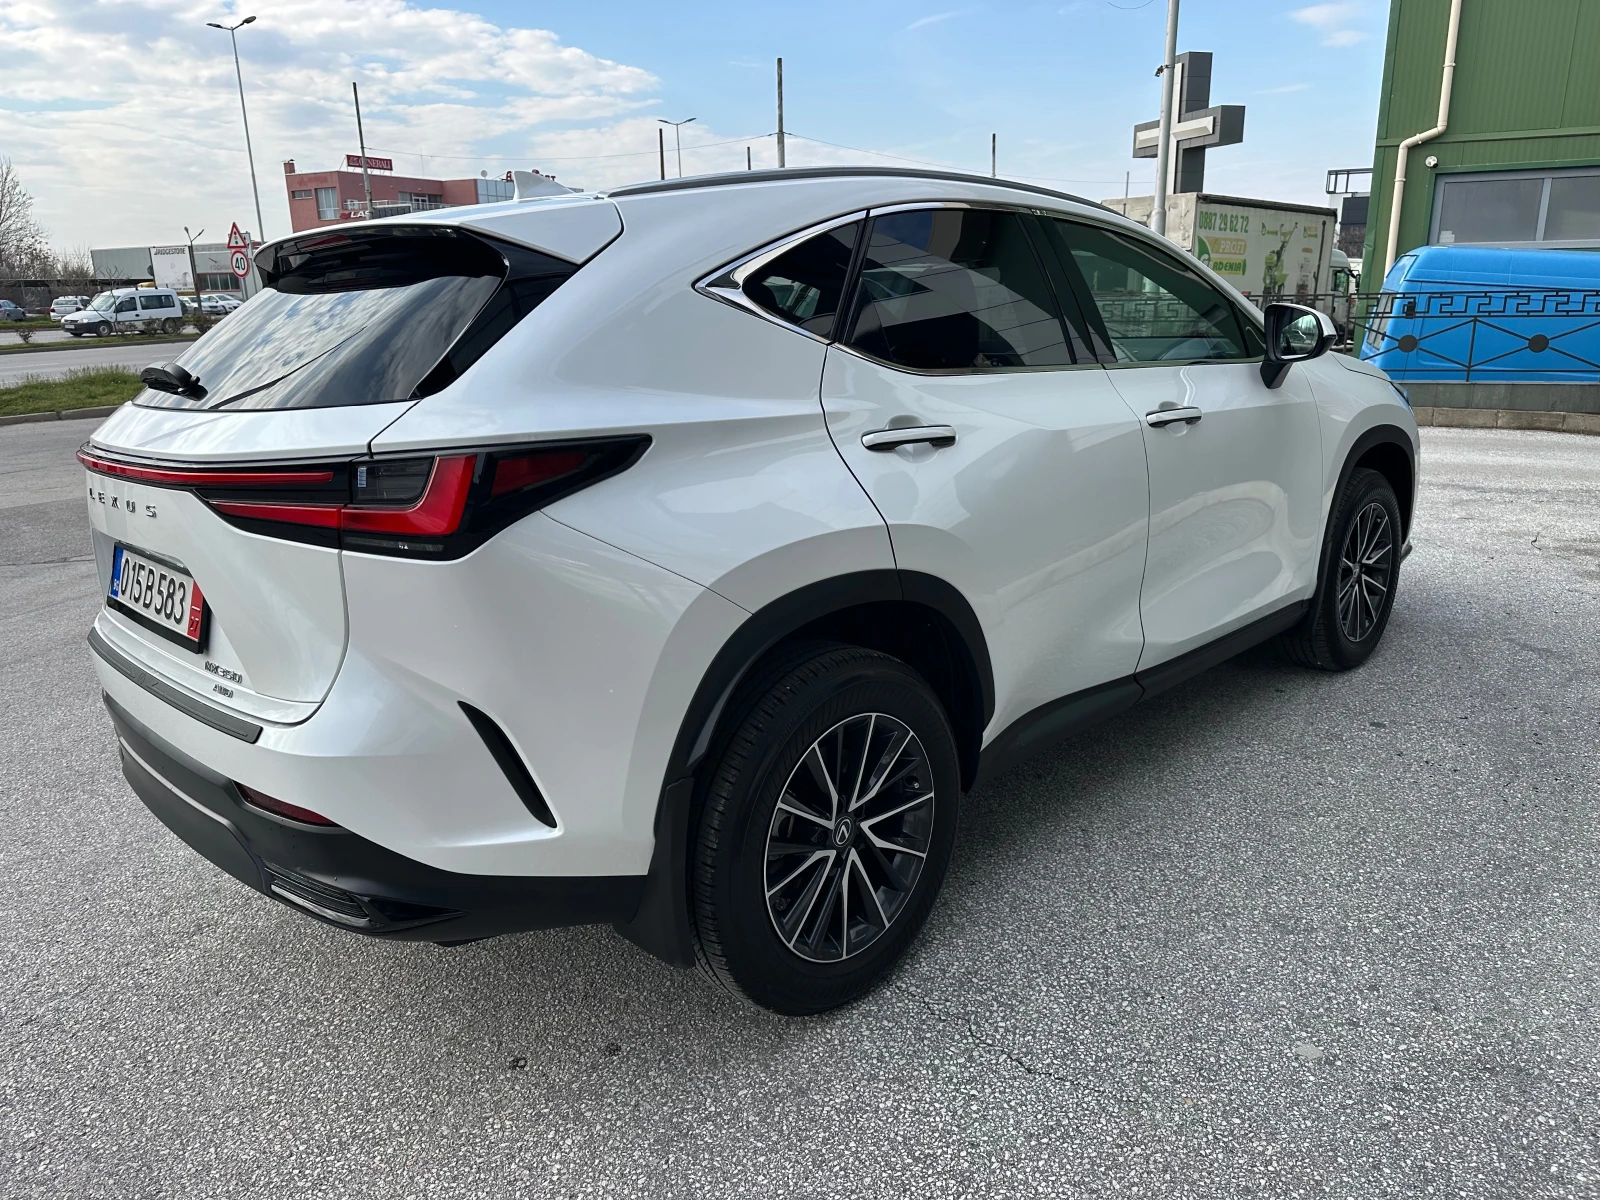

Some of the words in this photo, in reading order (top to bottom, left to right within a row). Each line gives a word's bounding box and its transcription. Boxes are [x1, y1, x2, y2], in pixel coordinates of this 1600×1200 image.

[358, 157, 391, 169] GNERALI
[1199, 211, 1217, 230] 0887
[1219, 213, 1228, 232] 29
[1230, 214, 1239, 233] 62
[1240, 215, 1249, 233] 72
[154, 247, 186, 256] BRIDGESTONE
[1219, 240, 1245, 254] PROFI
[235, 257, 245, 270] 40
[89, 488, 157, 518] LEXUS
[120, 556, 187, 625] 015B583
[189, 617, 200, 633] 27
